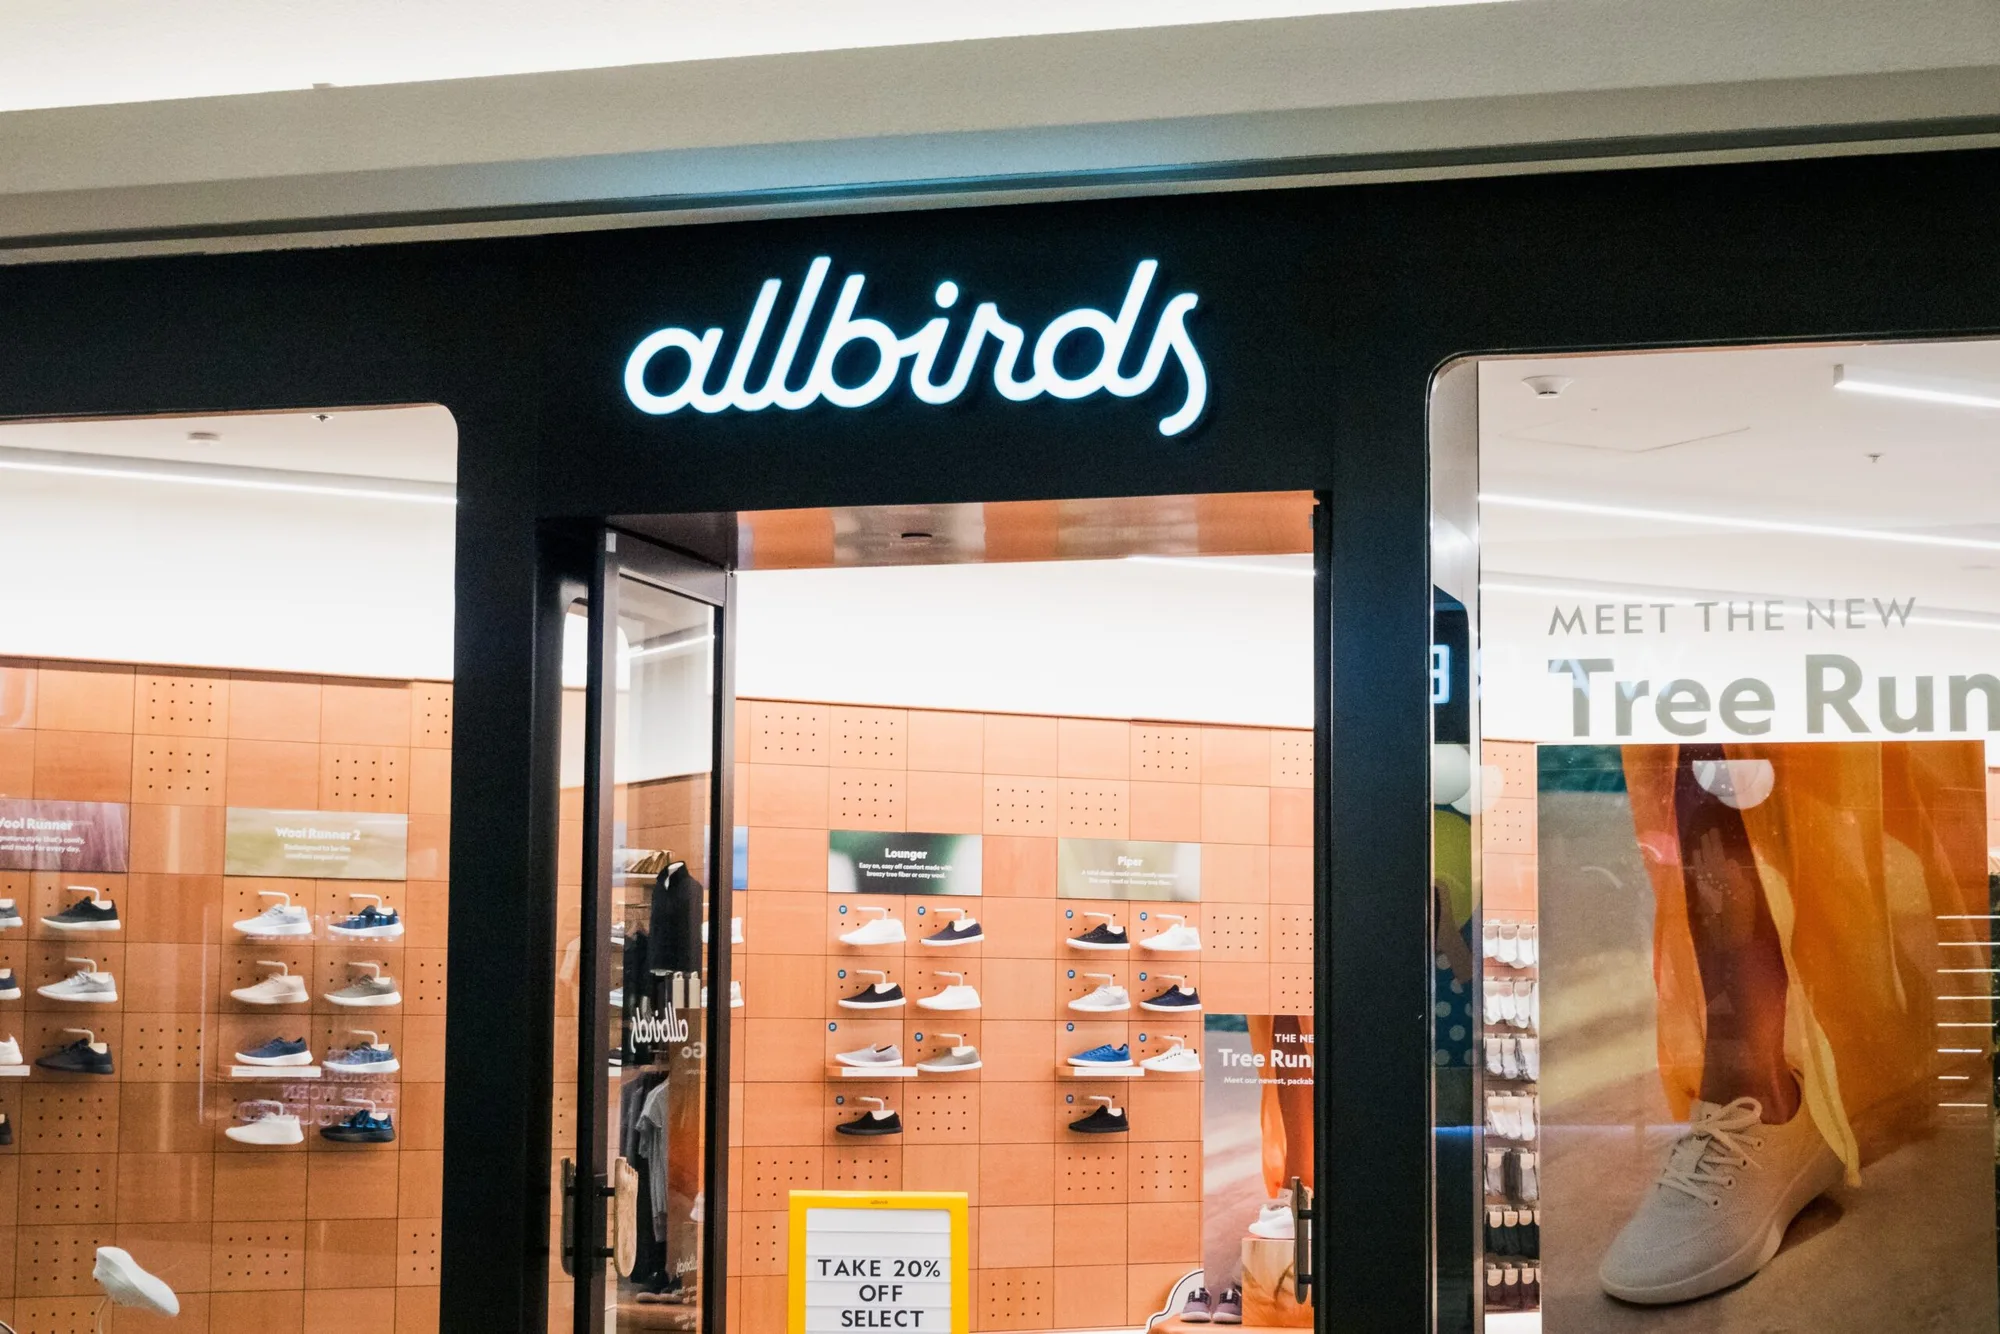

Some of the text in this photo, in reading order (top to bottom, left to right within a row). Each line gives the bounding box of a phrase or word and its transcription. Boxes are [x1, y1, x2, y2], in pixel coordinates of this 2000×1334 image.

[624, 256, 1207, 436] allbirds
[1548, 597, 1917, 636] MEET THE NEW
[1547, 653, 2000, 738] Tree Run
[27, 818, 73, 831] Runner
[275, 827, 361, 841] Wool Runner 2
[885, 848, 928, 862] Lounger
[1117, 855, 1144, 869] Piper
[859, 862, 872, 870] Easy
[903, 863, 925, 871] comfort
[1275, 1033, 1297, 1043] THE
[1218, 1048, 1313, 1068] Tree Run
[1224, 1076, 1244, 1084] Meet
[817, 1259, 941, 1278] TAKE 20%
[859, 1284, 903, 1302] OFF
[841, 1309, 924, 1328] SELECT
